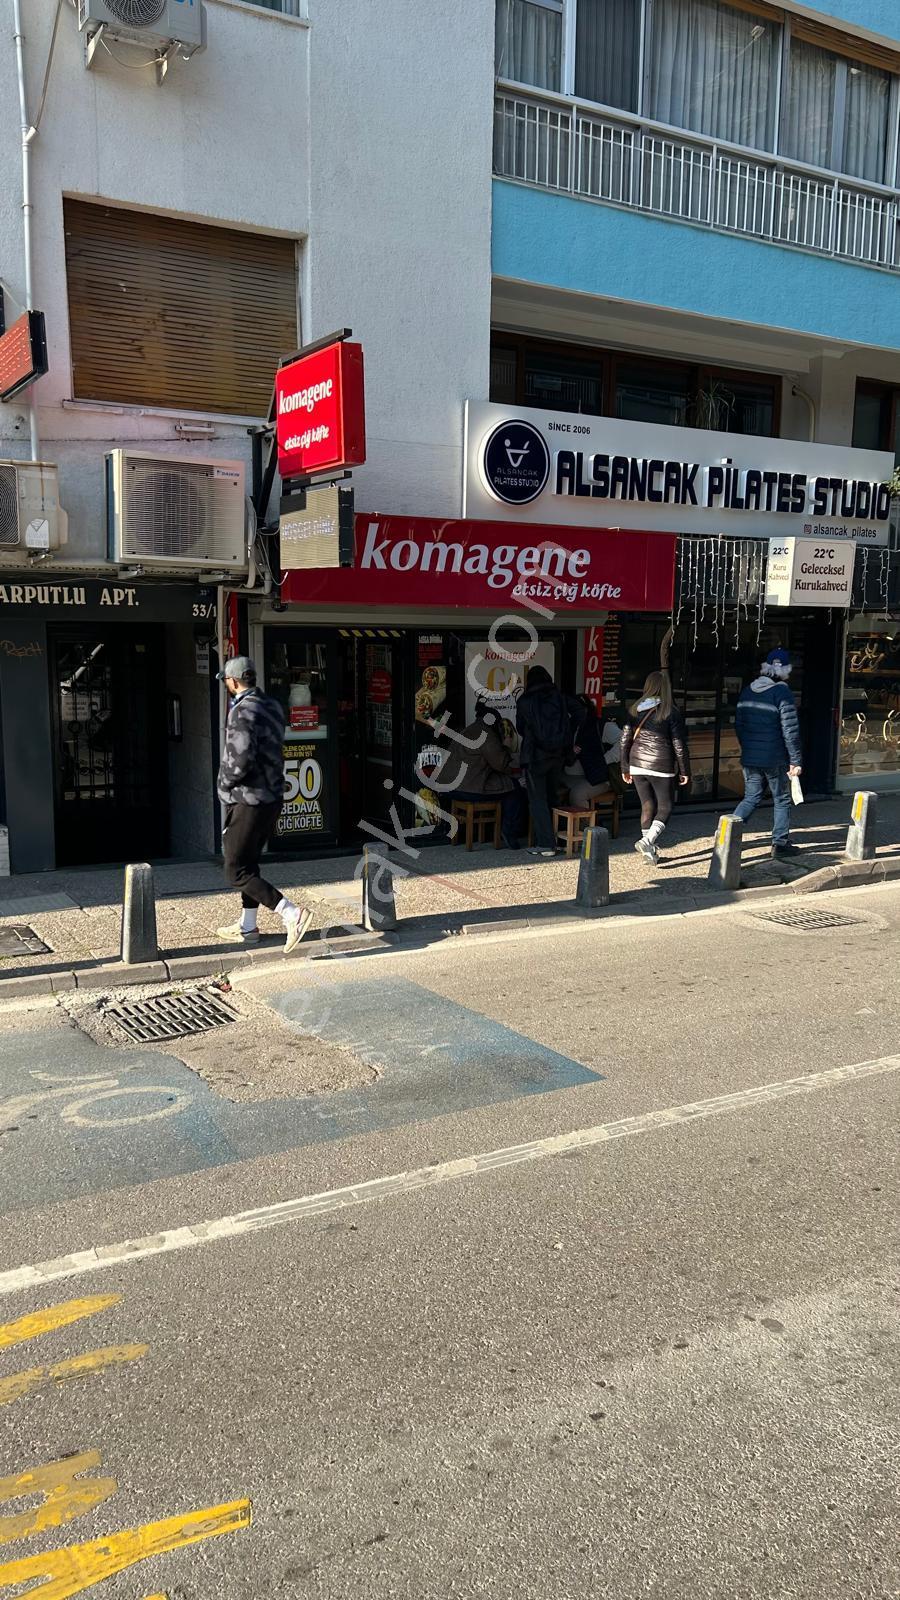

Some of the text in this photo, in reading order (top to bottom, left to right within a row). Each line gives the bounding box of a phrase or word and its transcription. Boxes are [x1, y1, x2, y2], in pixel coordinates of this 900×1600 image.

[279, 378, 333, 416] komagene
[572, 424, 591, 435] 2006
[284, 432, 301, 451] etsiz
[311, 424, 330, 444] köfte
[496, 467, 538, 477] ALSANCAK
[518, 479, 540, 488] STUDIO
[554, 450, 890, 521] ALSANCAK PİLATES STUDIO
[813, 523, 877, 539] alsancak_pilates
[360, 522, 592, 589] komagene
[800, 562, 845, 576] Geleceksel
[512, 582, 622, 602] etsiz çiğ köfte
[794, 579, 848, 592] Kurukahveci
[100, 587, 140, 606] APT.
[280, 801, 320, 815] BEDAVA
[294, 814, 323, 829] KÖFTE
